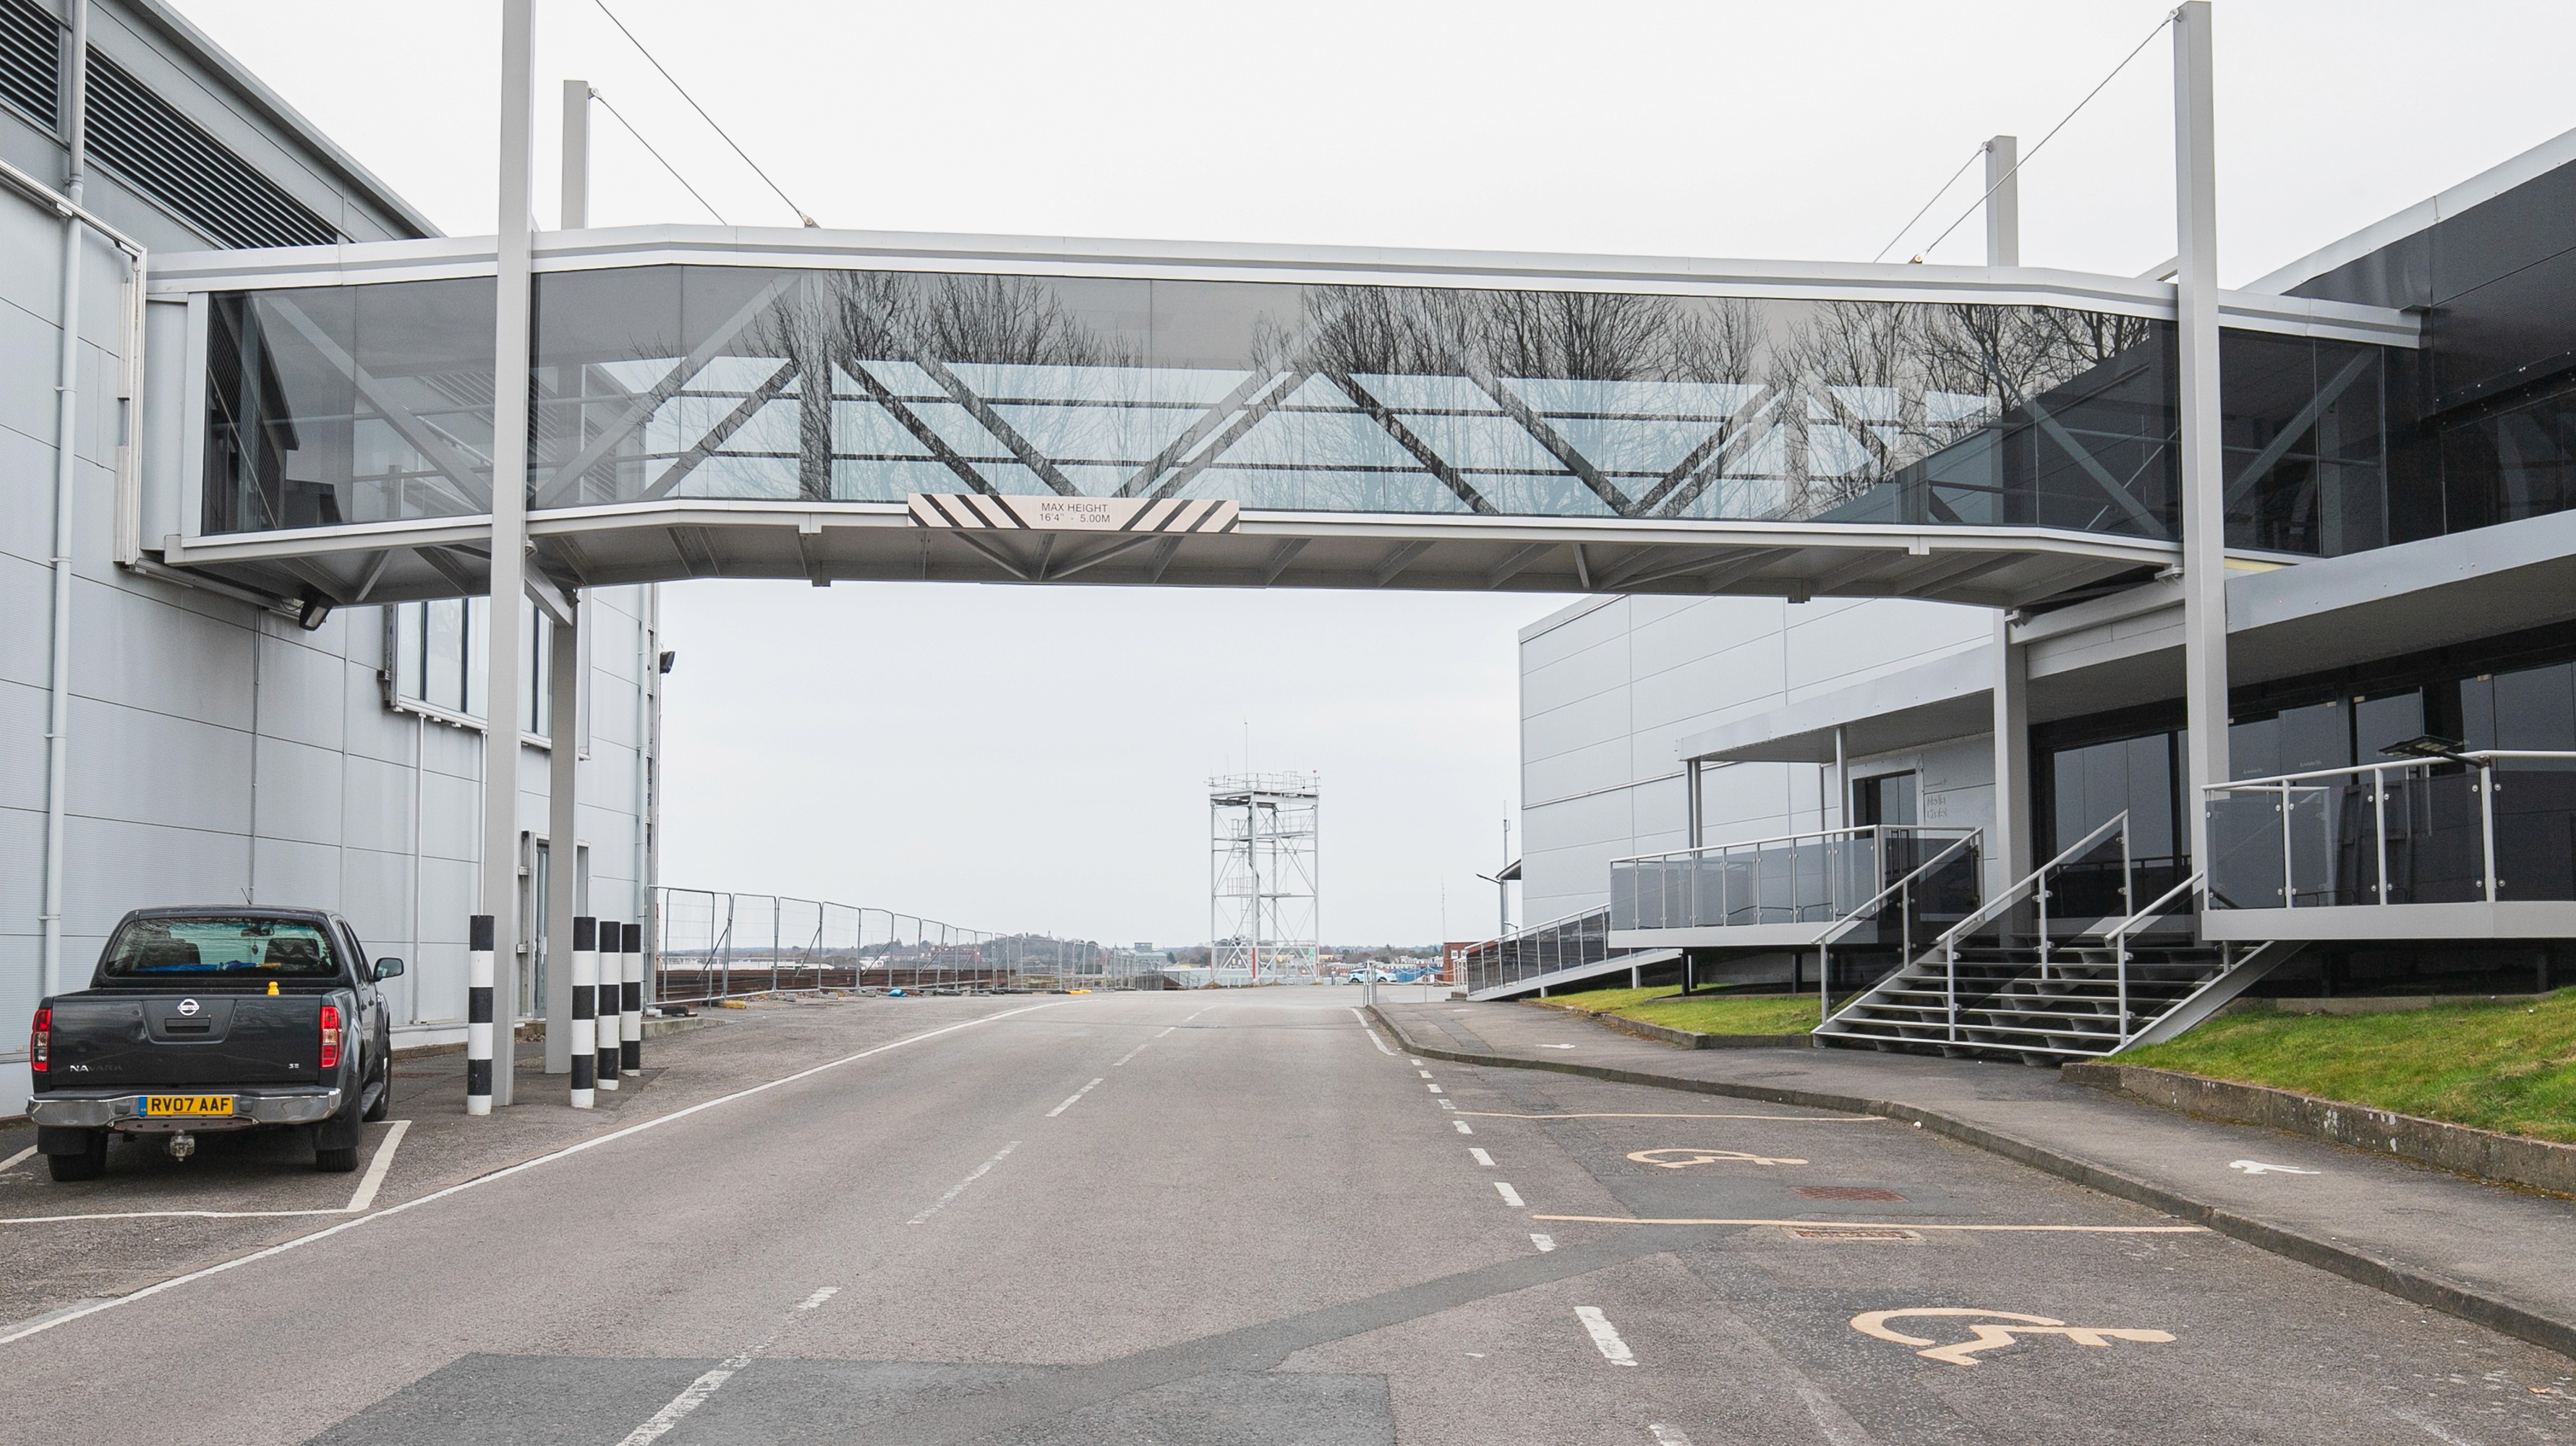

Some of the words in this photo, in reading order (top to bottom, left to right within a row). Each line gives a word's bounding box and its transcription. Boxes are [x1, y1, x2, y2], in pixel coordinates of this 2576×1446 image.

[1041, 502, 1065, 512] MAX
[1067, 503, 1108, 513] HEIGHT
[1080, 514, 1110, 523] 5.00M
[151, 1098, 195, 1112] RV07
[199, 1098, 230, 1112] AAF
